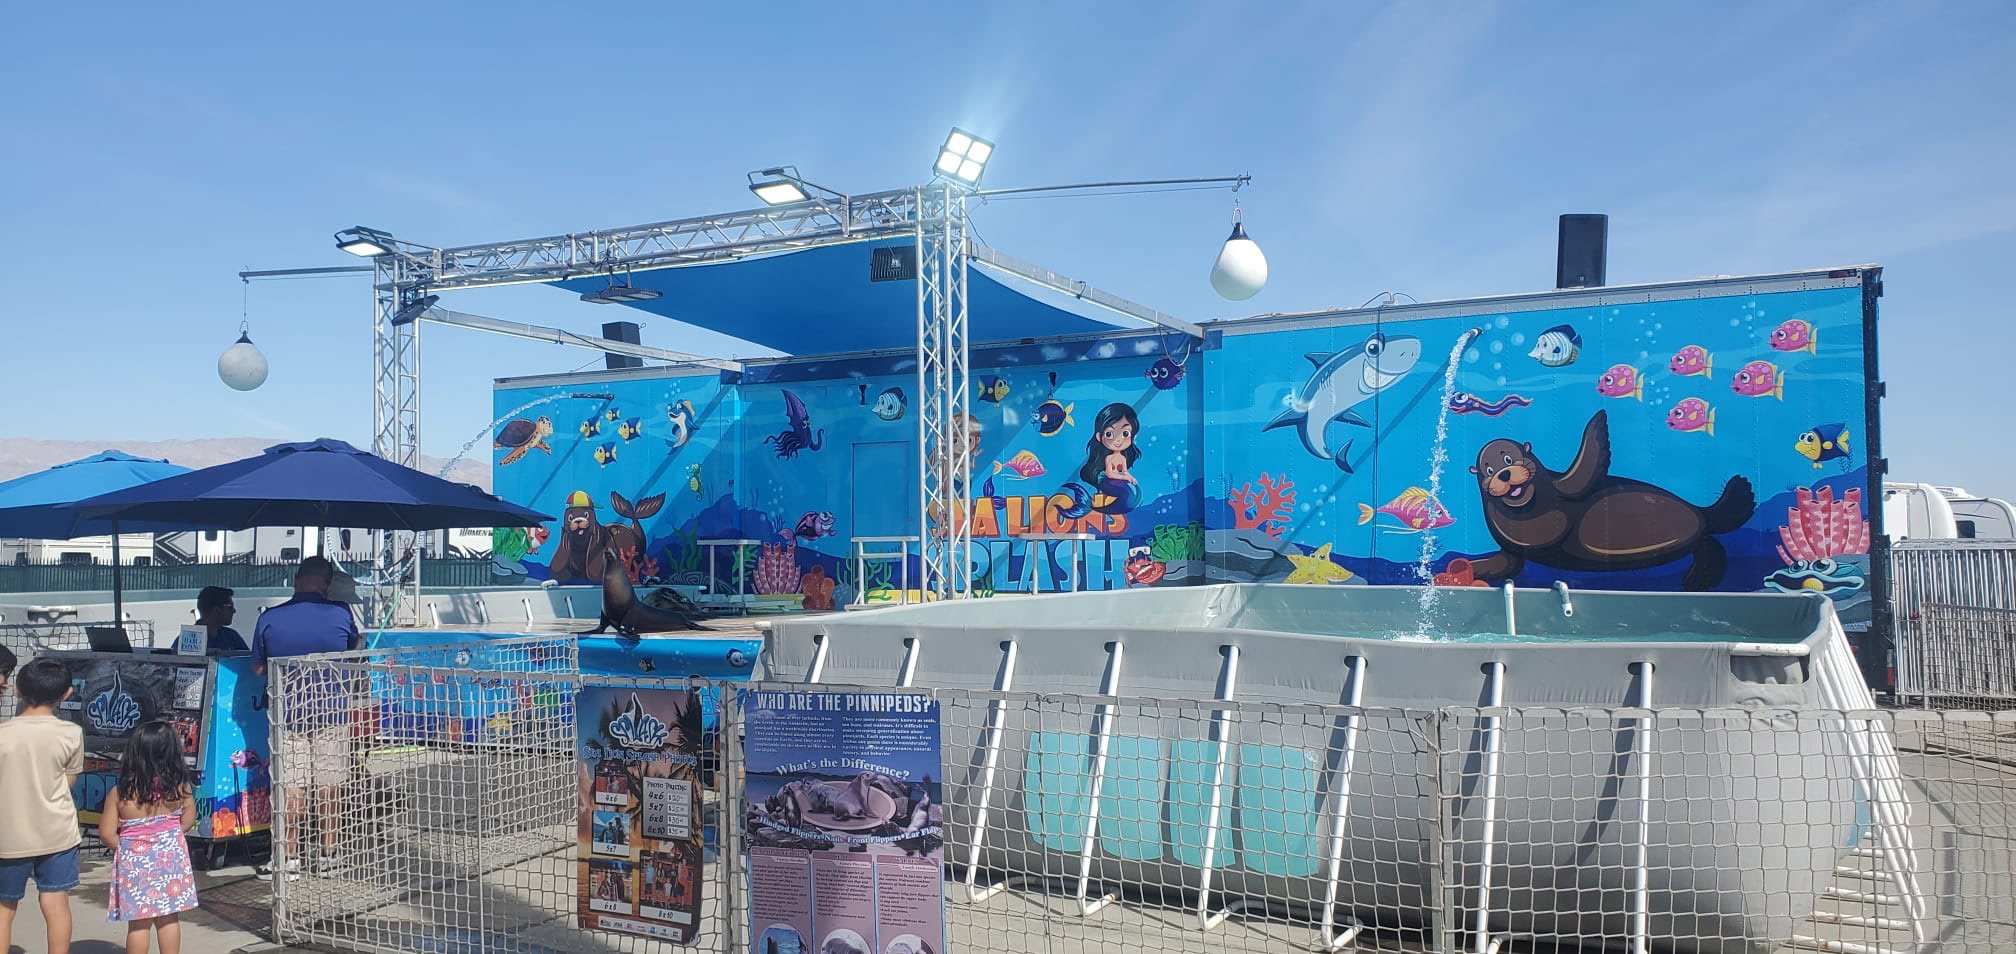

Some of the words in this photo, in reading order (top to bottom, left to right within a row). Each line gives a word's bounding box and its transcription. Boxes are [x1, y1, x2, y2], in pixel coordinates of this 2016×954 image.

[928, 497, 999, 538] SA
[757, 693, 784, 710] WHO
[789, 694, 813, 710] ARE
[818, 694, 842, 711] THE
[846, 694, 931, 713] PINNIPEDS?
[776, 760, 817, 776] What's
[820, 758, 838, 768] the
[842, 758, 910, 780] Difference?
[648, 791, 664, 800] 4x6
[648, 802, 664, 812] 5x7
[649, 814, 664, 822] 6x8
